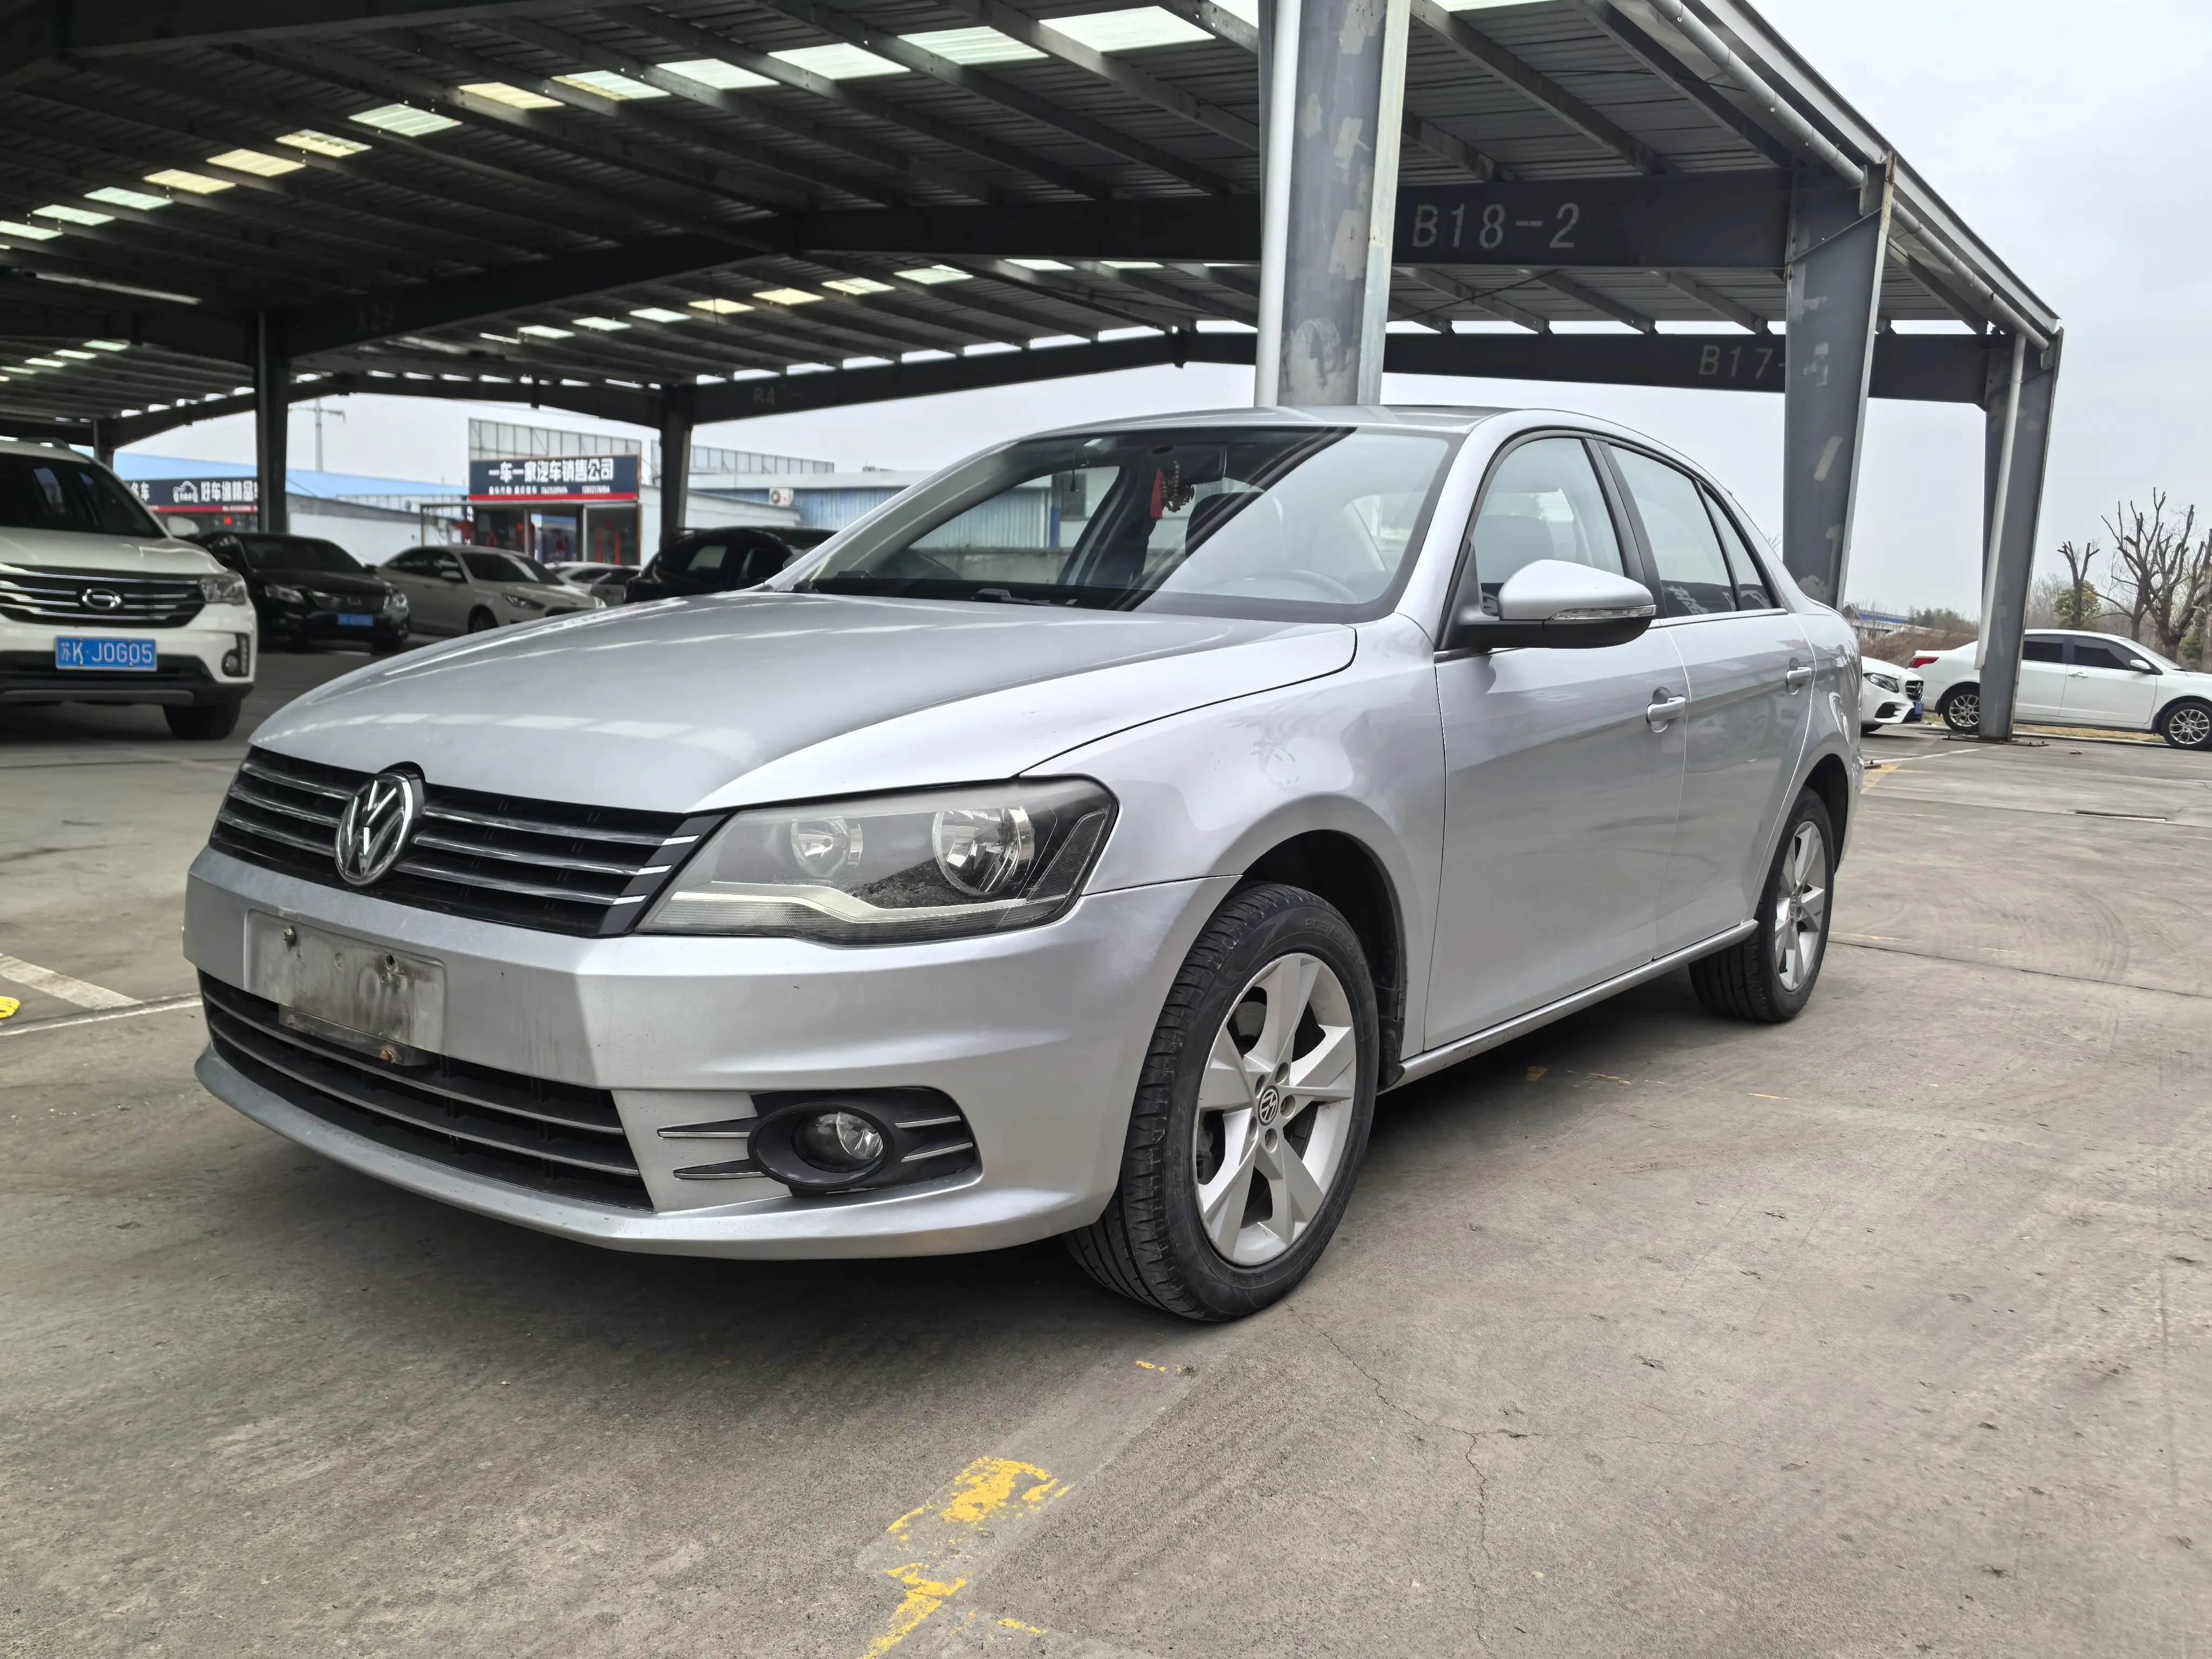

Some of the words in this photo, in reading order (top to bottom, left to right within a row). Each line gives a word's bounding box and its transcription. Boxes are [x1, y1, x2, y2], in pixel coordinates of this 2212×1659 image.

[1412, 203, 1580, 249] B18-2
[488, 457, 615, 483] 一车一家汽车销售公司
